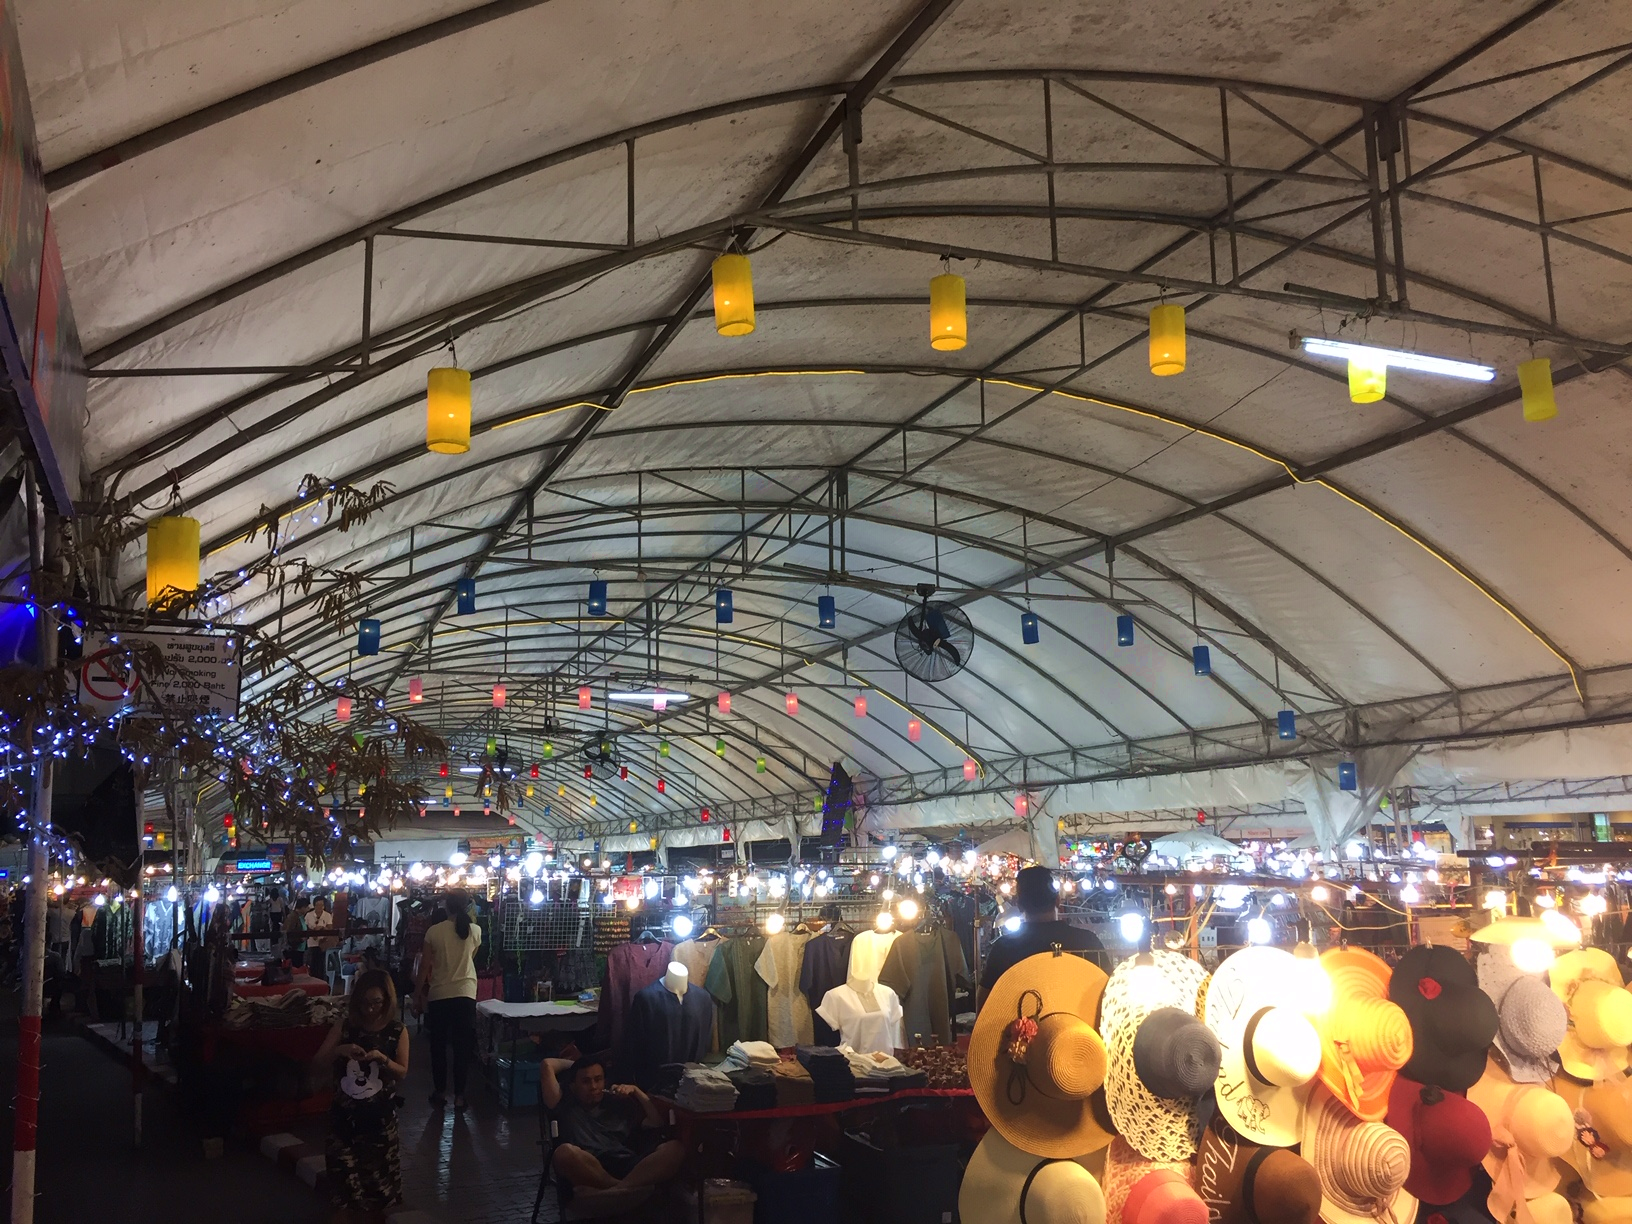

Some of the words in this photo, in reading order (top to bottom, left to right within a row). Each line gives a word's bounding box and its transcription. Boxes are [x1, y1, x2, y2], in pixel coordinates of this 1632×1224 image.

[188, 655, 217, 664] 2,000
[180, 669, 216, 679] moking
[204, 682, 226, 690] Baht
